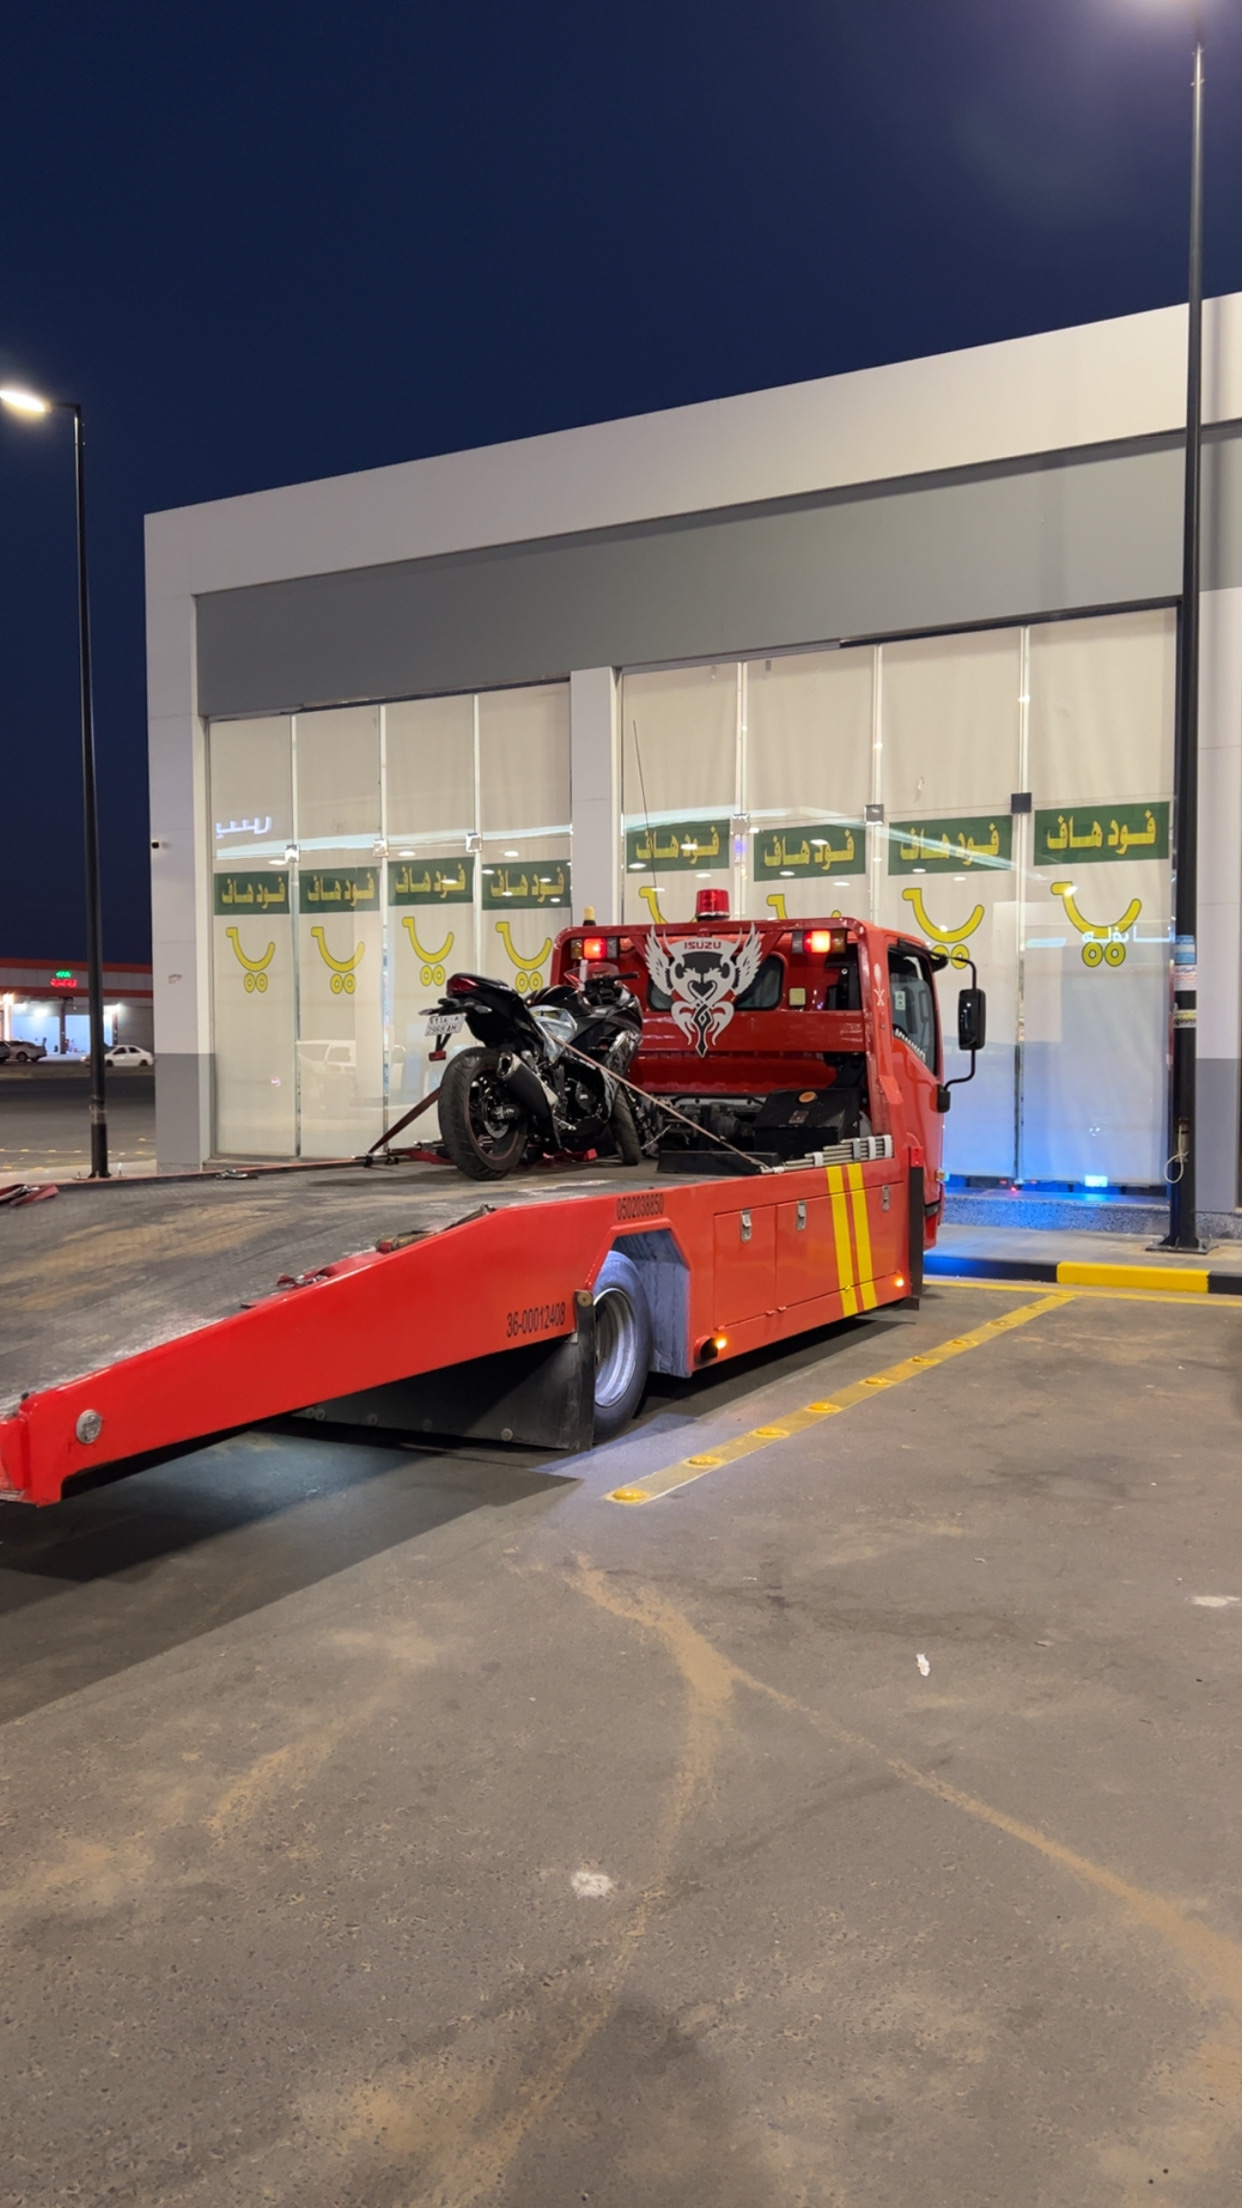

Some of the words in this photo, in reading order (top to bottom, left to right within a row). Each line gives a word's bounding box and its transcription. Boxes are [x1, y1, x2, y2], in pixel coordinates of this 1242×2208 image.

[1047, 815, 1103, 850] هاف
[1108, 810, 1157, 855] فود
[221, 877, 254, 904] هاف
[256, 876, 286, 909] فود
[307, 875, 341, 901] هاف
[344, 872, 375, 907] فود
[684, 941, 721, 950] ISUZU
[506, 1301, 566, 1338] 36-00012408
